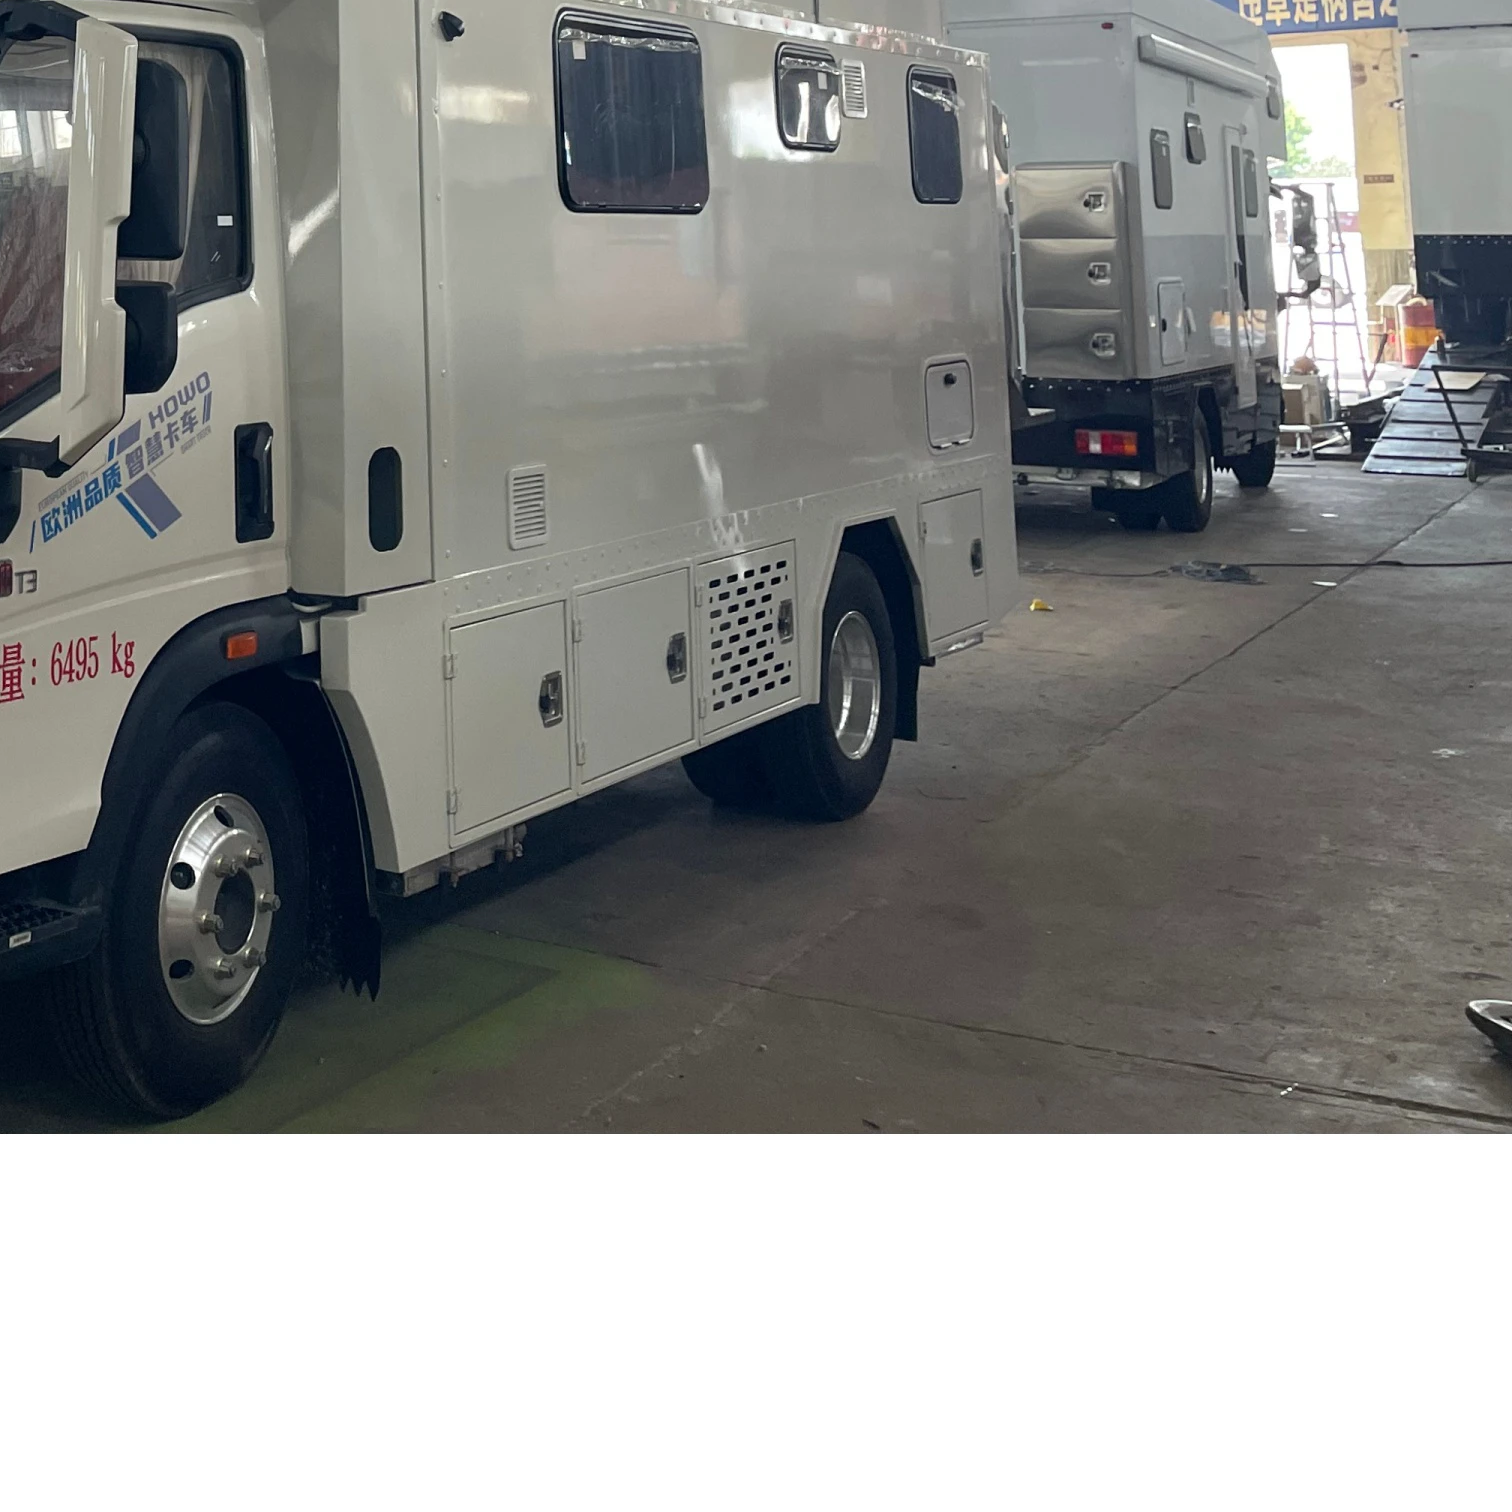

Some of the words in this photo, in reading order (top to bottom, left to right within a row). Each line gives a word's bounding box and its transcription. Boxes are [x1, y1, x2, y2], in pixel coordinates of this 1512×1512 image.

[148, 371, 210, 429] HOWO
[40, 460, 123, 543] 欧洲品质
[125, 406, 198, 480] 智慧卡车
[14, 569, 38, 595] T3
[50, 635, 99, 686] 6495
[111, 630, 135, 678] kg
